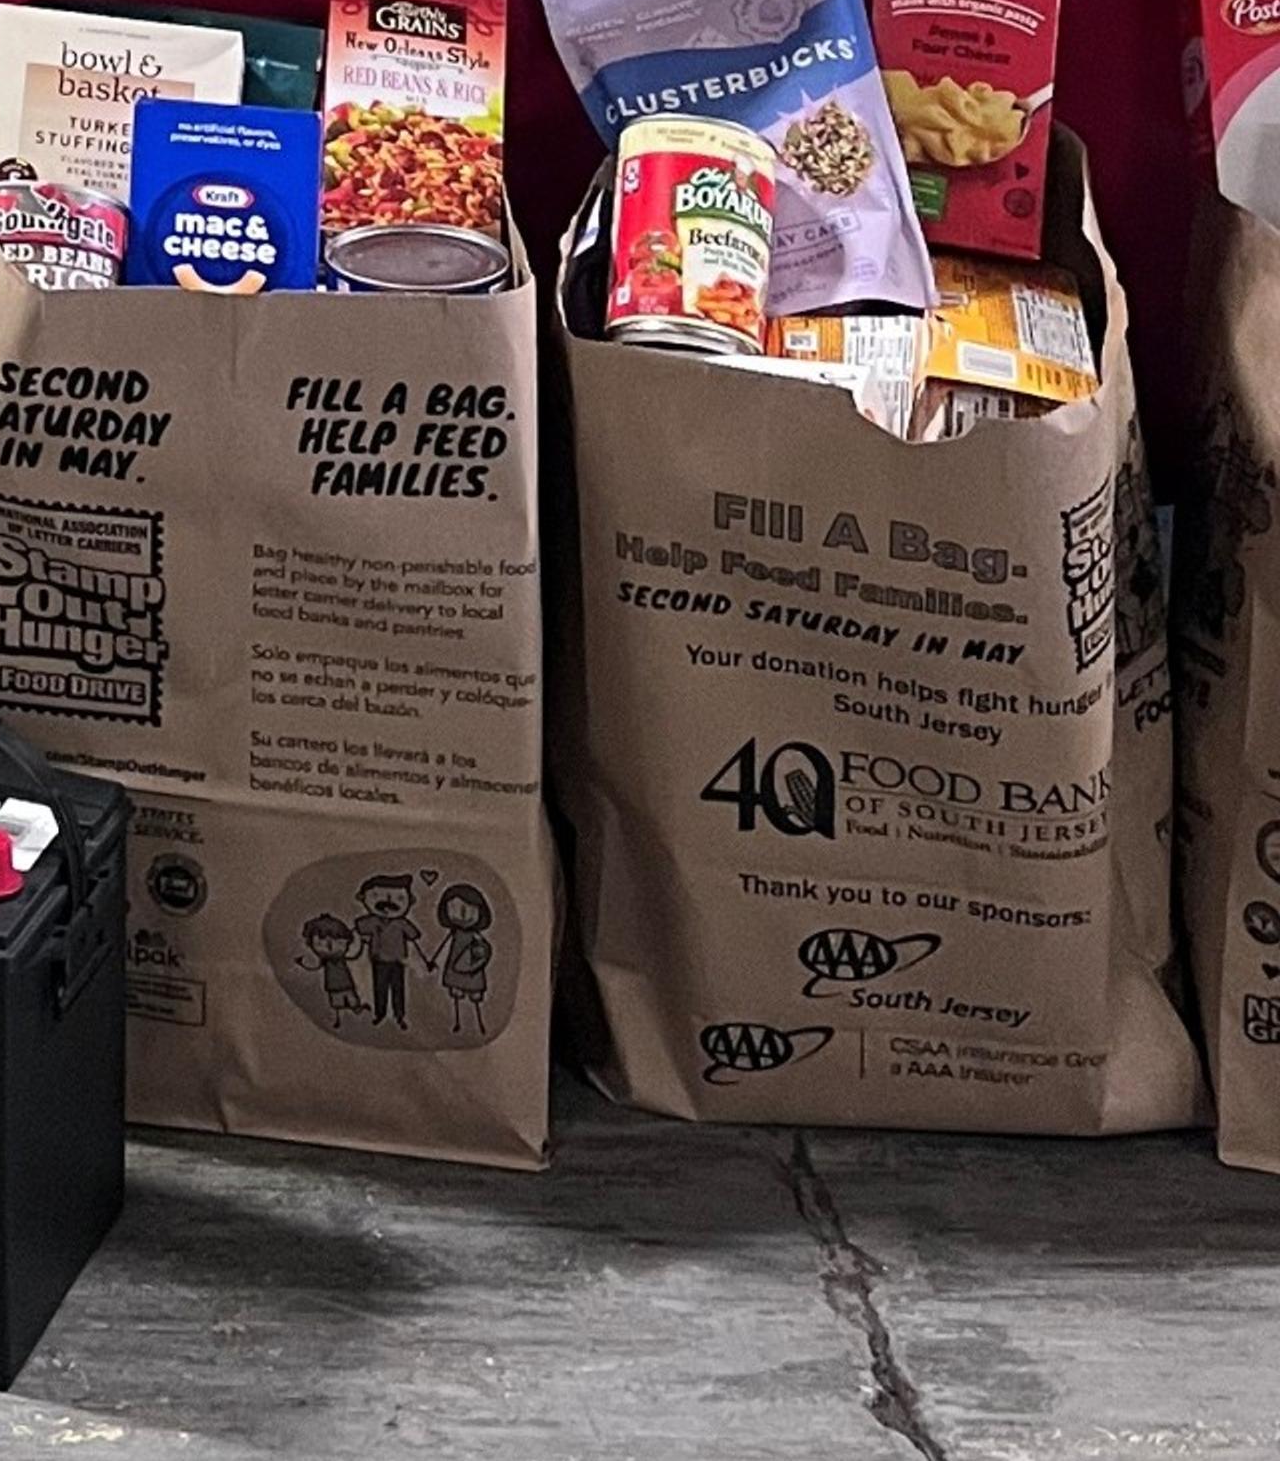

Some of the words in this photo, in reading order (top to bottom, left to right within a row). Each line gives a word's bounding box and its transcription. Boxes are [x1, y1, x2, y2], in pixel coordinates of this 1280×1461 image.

[376, 7, 463, 39] GRAINS
[61, 41, 131, 74] bowl
[139, 55, 162, 77] &
[346, 31, 378, 51] New
[384, 37, 443, 61] Orleans
[343, 66, 377, 86] RED
[382, 69, 432, 95] BEANS
[606, 38, 854, 124] CLUSTERBUCKS
[205, 191, 239, 203] Kraft
[175, 213, 243, 236] mac
[245, 215, 269, 240] &
[42, 245, 113, 275] BEANS
[287, 378, 364, 412] FILL
[382, 383, 408, 414] A
[425, 384, 517, 420] BAG.
[298, 419, 397, 455] HELP
[414, 424, 508, 459] FEED
[311, 462, 499, 501] FAMILIES.
[714, 491, 805, 544] Fill
[824, 514, 869, 553] A
[889, 521, 1030, 583] Bag.
[806, 931, 890, 977] AAA
[849, 987, 934, 1014] South
[940, 995, 1033, 1028] Jersey
